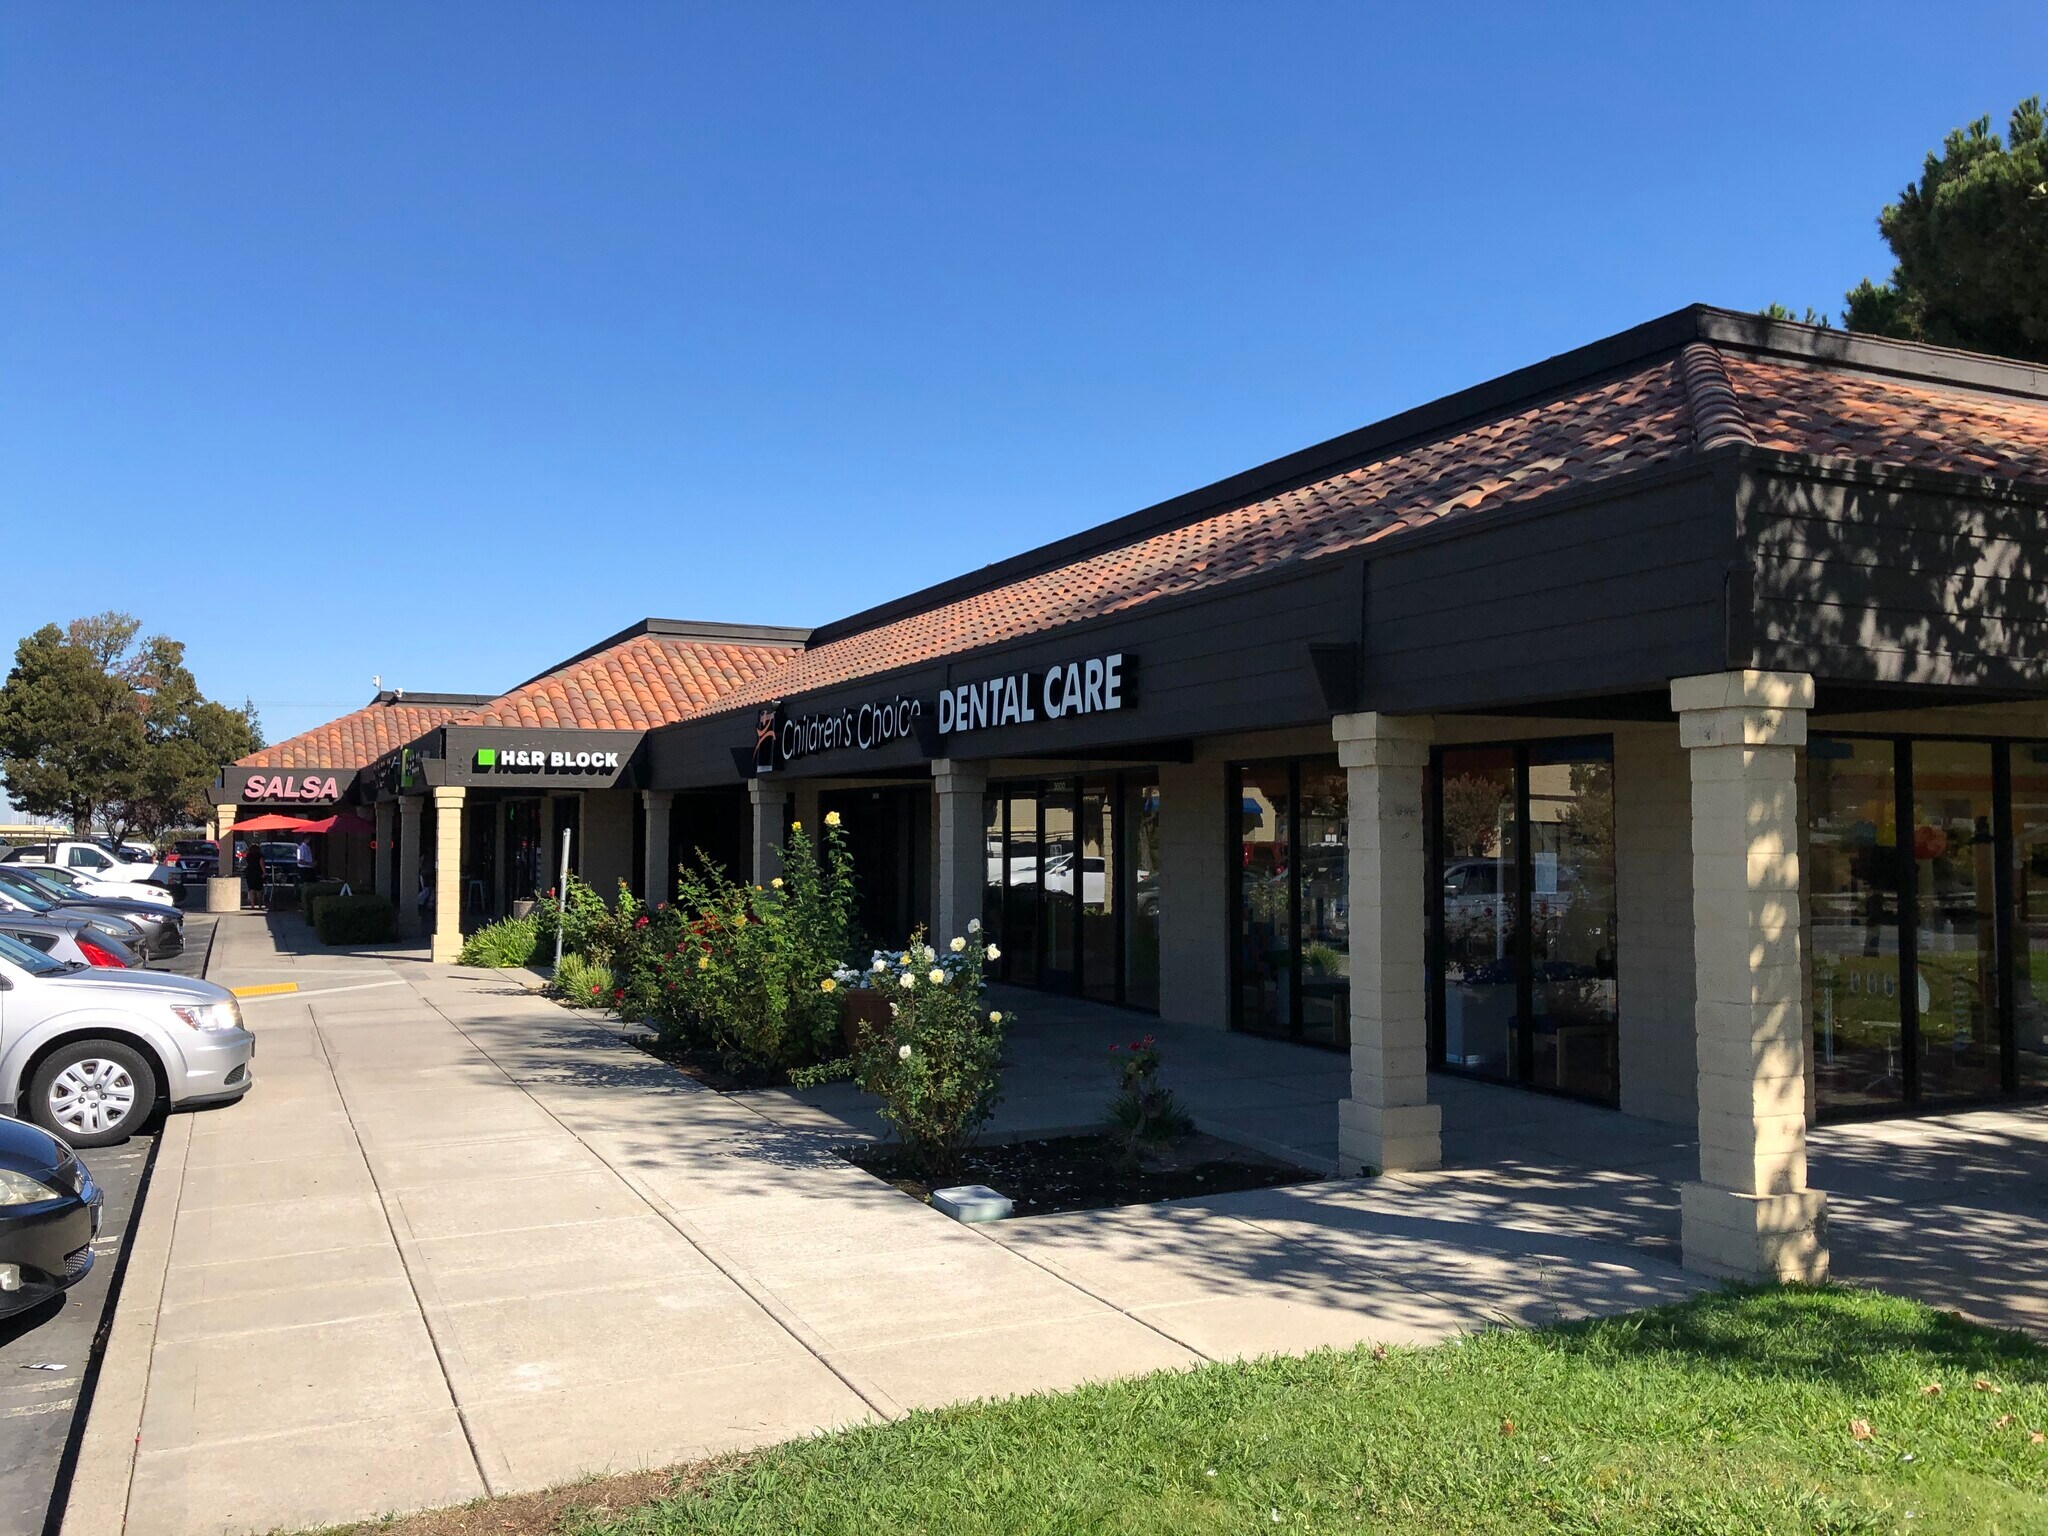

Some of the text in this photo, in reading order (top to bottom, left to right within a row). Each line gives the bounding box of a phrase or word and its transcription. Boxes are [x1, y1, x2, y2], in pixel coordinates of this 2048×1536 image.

[781, 707, 853, 760] Children's
[938, 672, 1035, 735] DENTAL
[1043, 653, 1122, 720] CARE
[500, 750, 619, 767] H&R BLOCK
[244, 775, 339, 799] SALSA
